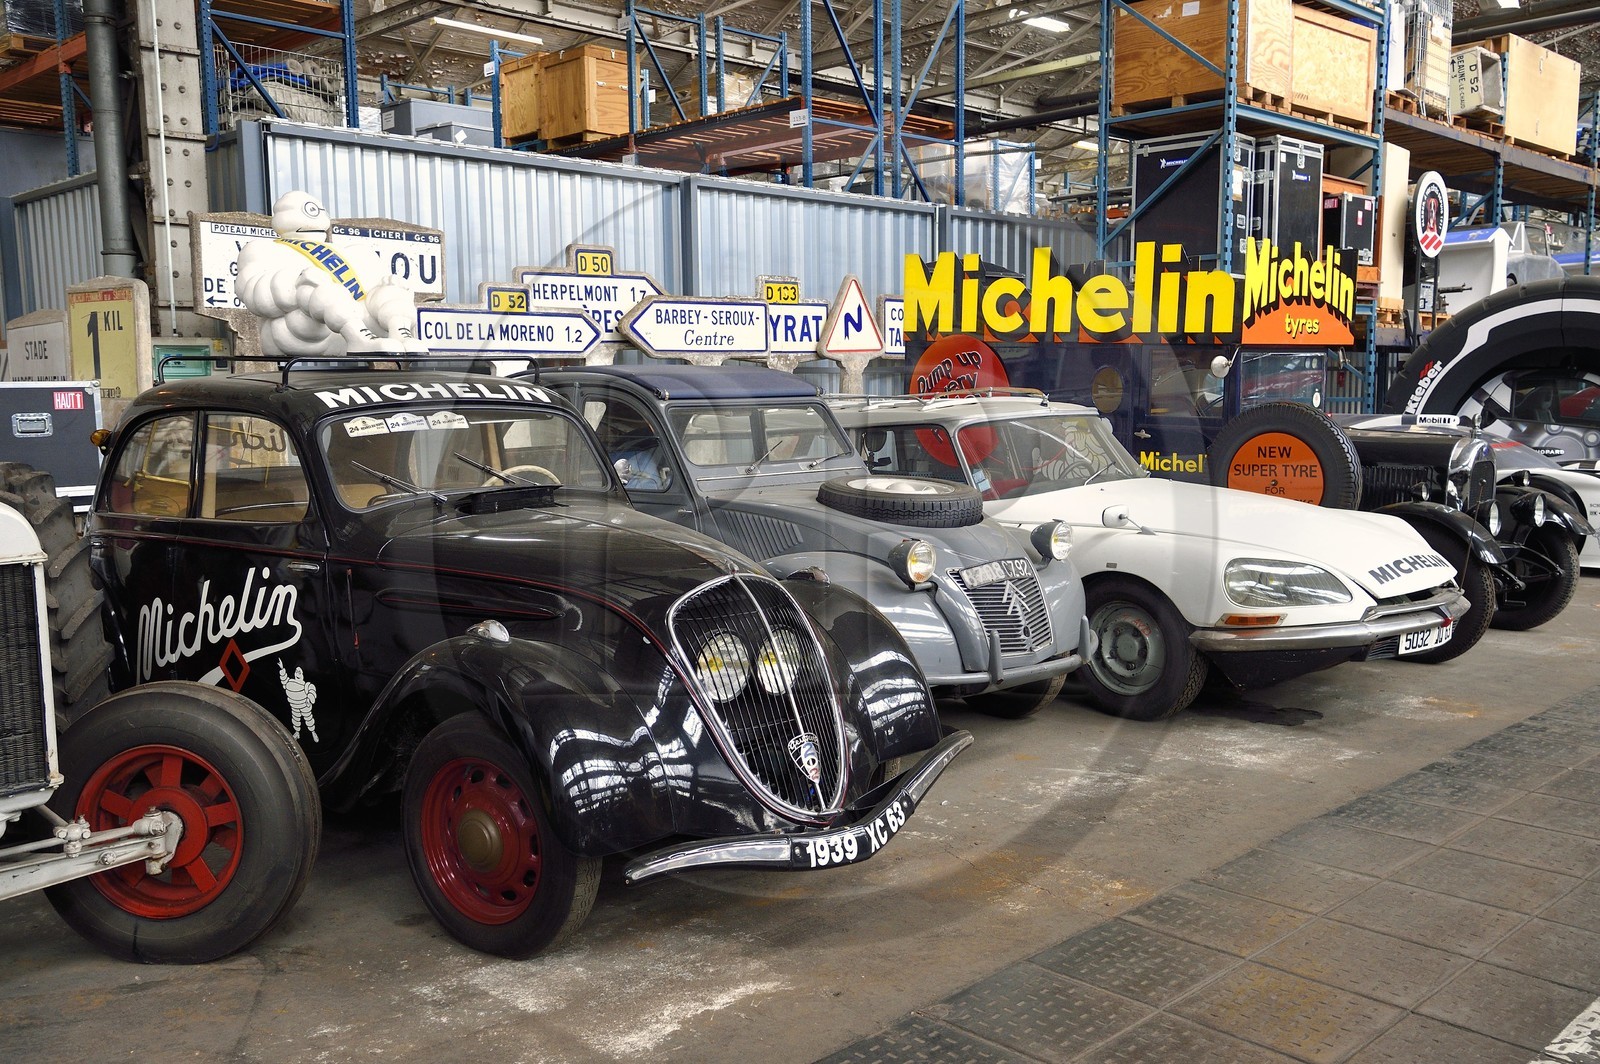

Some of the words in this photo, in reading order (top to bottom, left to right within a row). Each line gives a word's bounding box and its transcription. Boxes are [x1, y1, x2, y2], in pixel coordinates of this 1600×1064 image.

[1470, 77, 1479, 93] 52
[214, 224, 247, 234] POTEAU
[348, 227, 361, 236] 96
[374, 231, 401, 240] CHER
[428, 235, 440, 243] 96
[579, 255, 587, 270] D
[592, 256, 609, 273] 50
[204, 277, 226, 293] DE
[904, 241, 1235, 333] Michelin
[1243, 236, 1354, 322] Michelin
[492, 293, 501, 308] D
[508, 294, 526, 310] 52
[533, 283, 619, 302] HERPELMONT
[766, 285, 774, 301] D
[424, 321, 452, 340] COL
[456, 323, 473, 341] DE
[478, 323, 495, 341] LA
[499, 324, 555, 342] MORENO
[1285, 313, 1320, 338] tyres
[86, 311, 101, 380] 1
[104, 310, 123, 331] KIL
[683, 330, 735, 346] Centre
[24, 340, 48, 361] STADE
[956, 350, 983, 369] up
[313, 383, 552, 409] MICHELIN
[1404, 360, 1443, 415] Kleber
[55, 391, 75, 409] HAUT
[390, 421, 400, 429] 24
[1418, 416, 1442, 424] Mobil
[348, 426, 360, 434] 24
[1257, 446, 1292, 459] NEW
[1140, 451, 1208, 473] Michel
[1233, 463, 1278, 477] SUPER
[1283, 464, 1318, 478] TYRE
[1264, 486, 1286, 495] FOR
[1367, 554, 1450, 585] MICHELIN
[136, 566, 302, 687] Michelin
[1404, 629, 1432, 651] 5032
[805, 832, 858, 869] 1939
[864, 818, 888, 853] XC
[885, 801, 906, 833] 63
